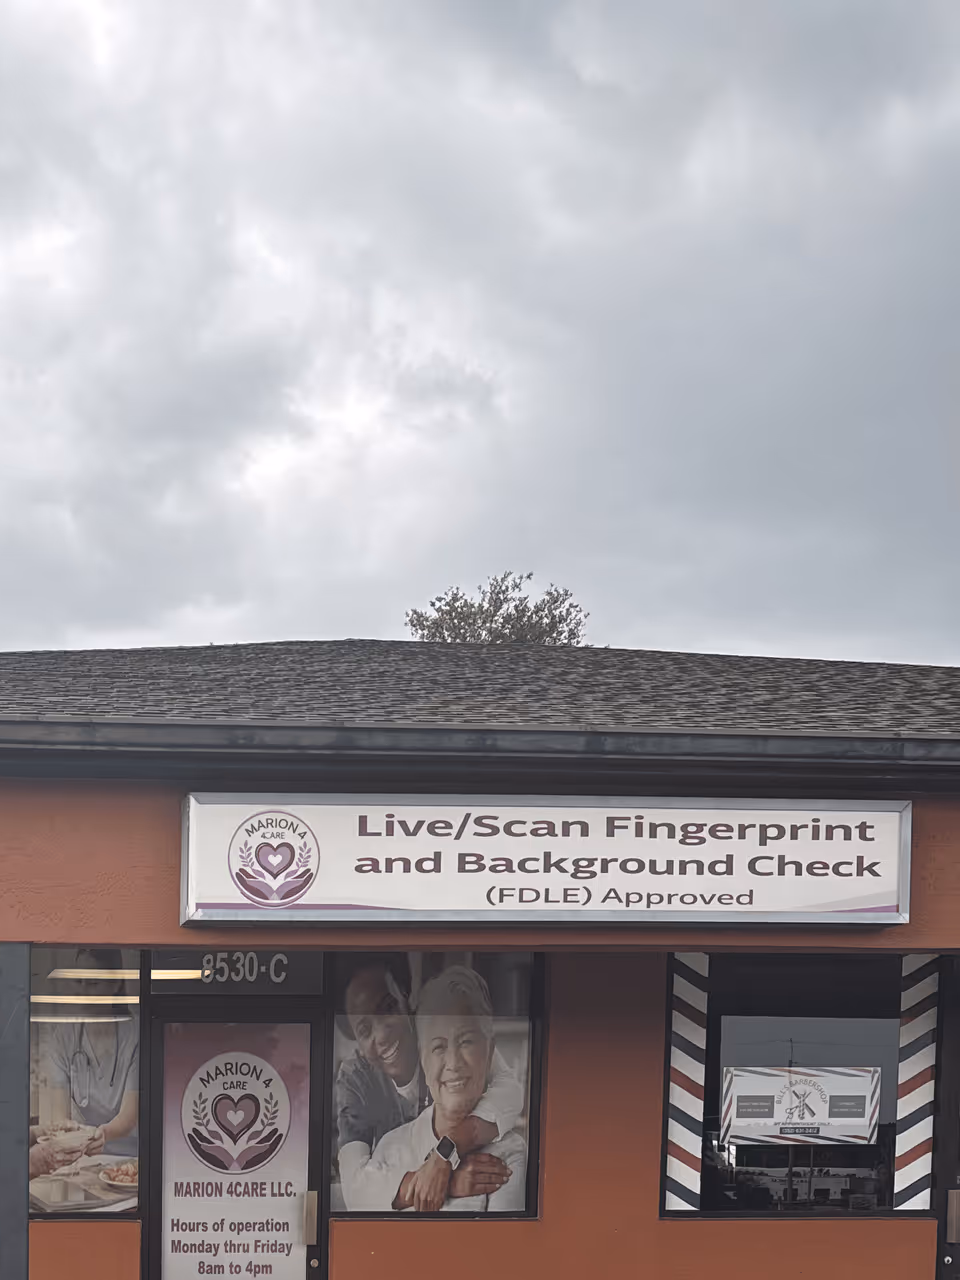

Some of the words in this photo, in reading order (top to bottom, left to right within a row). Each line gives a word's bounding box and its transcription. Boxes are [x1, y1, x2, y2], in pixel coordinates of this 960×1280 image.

[244, 818, 299, 837] MARION
[298, 831, 307, 840] 4
[358, 812, 589, 840] Live/Scan
[606, 815, 875, 846] Fingerprint
[354, 851, 442, 874] and
[457, 851, 734, 879] Background
[747, 855, 882, 877] Check
[486, 886, 592, 906] (FDLE)
[600, 888, 754, 908] Approved
[199, 1062, 263, 1088] MARION
[262, 1076, 273, 1089] 4
[222, 1080, 248, 1091] CARE
[788, 1079, 828, 1104] BARBERSHOP
[174, 1182, 223, 1198] MARION
[226, 1182, 267, 1198] 4CARE
[270, 1182, 297, 1198] LLC.
[170, 1218, 208, 1232] Hours
[212, 1218, 225, 1232] of
[229, 1218, 290, 1235] operation
[170, 1240, 220, 1256] Monday
[224, 1240, 250, 1253] thru
[254, 1240, 293, 1256] Friday
[197, 1261, 225, 1275] 8am
[228, 1262, 241, 1275] to
[245, 1260, 273, 1278] 4pm
